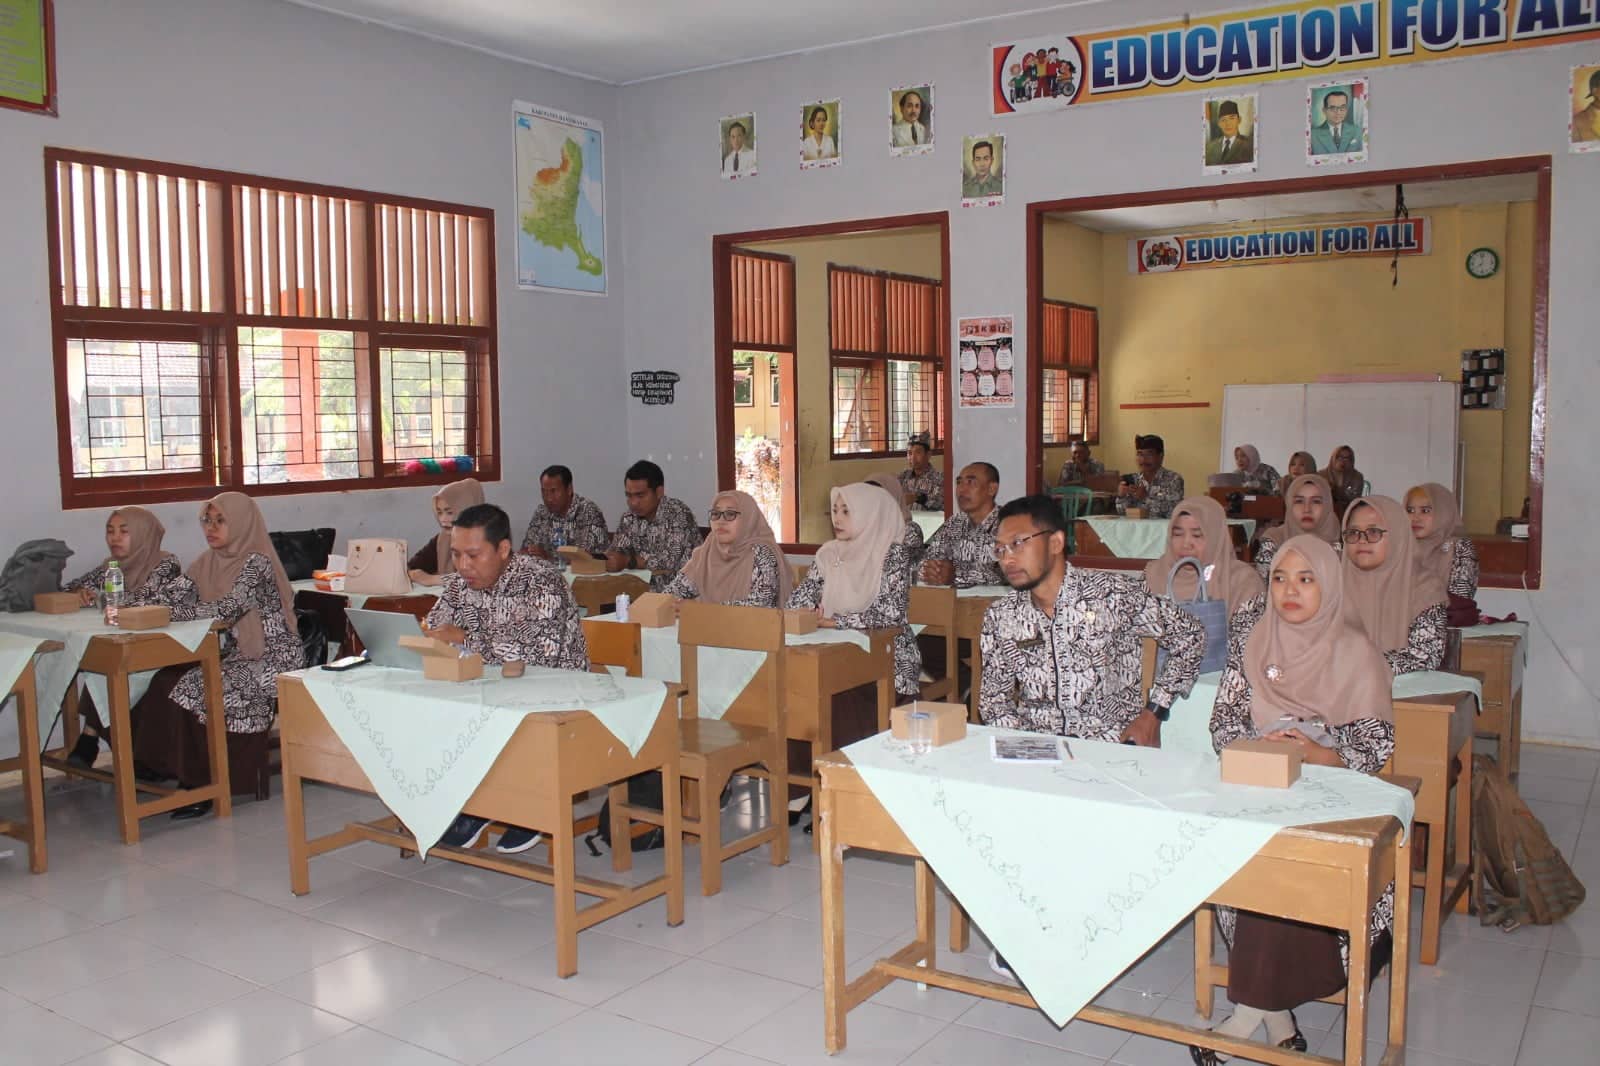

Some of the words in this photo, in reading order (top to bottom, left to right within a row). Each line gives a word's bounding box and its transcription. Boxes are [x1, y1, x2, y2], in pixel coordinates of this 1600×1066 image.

[1090, 1, 1376, 92] EDUCATION
[1389, 0, 1503, 52] FOR
[1514, 0, 1600, 36] AL
[1185, 229, 1316, 263] EDUCATION
[1320, 226, 1369, 254] FOR
[1373, 222, 1416, 249] ALL
